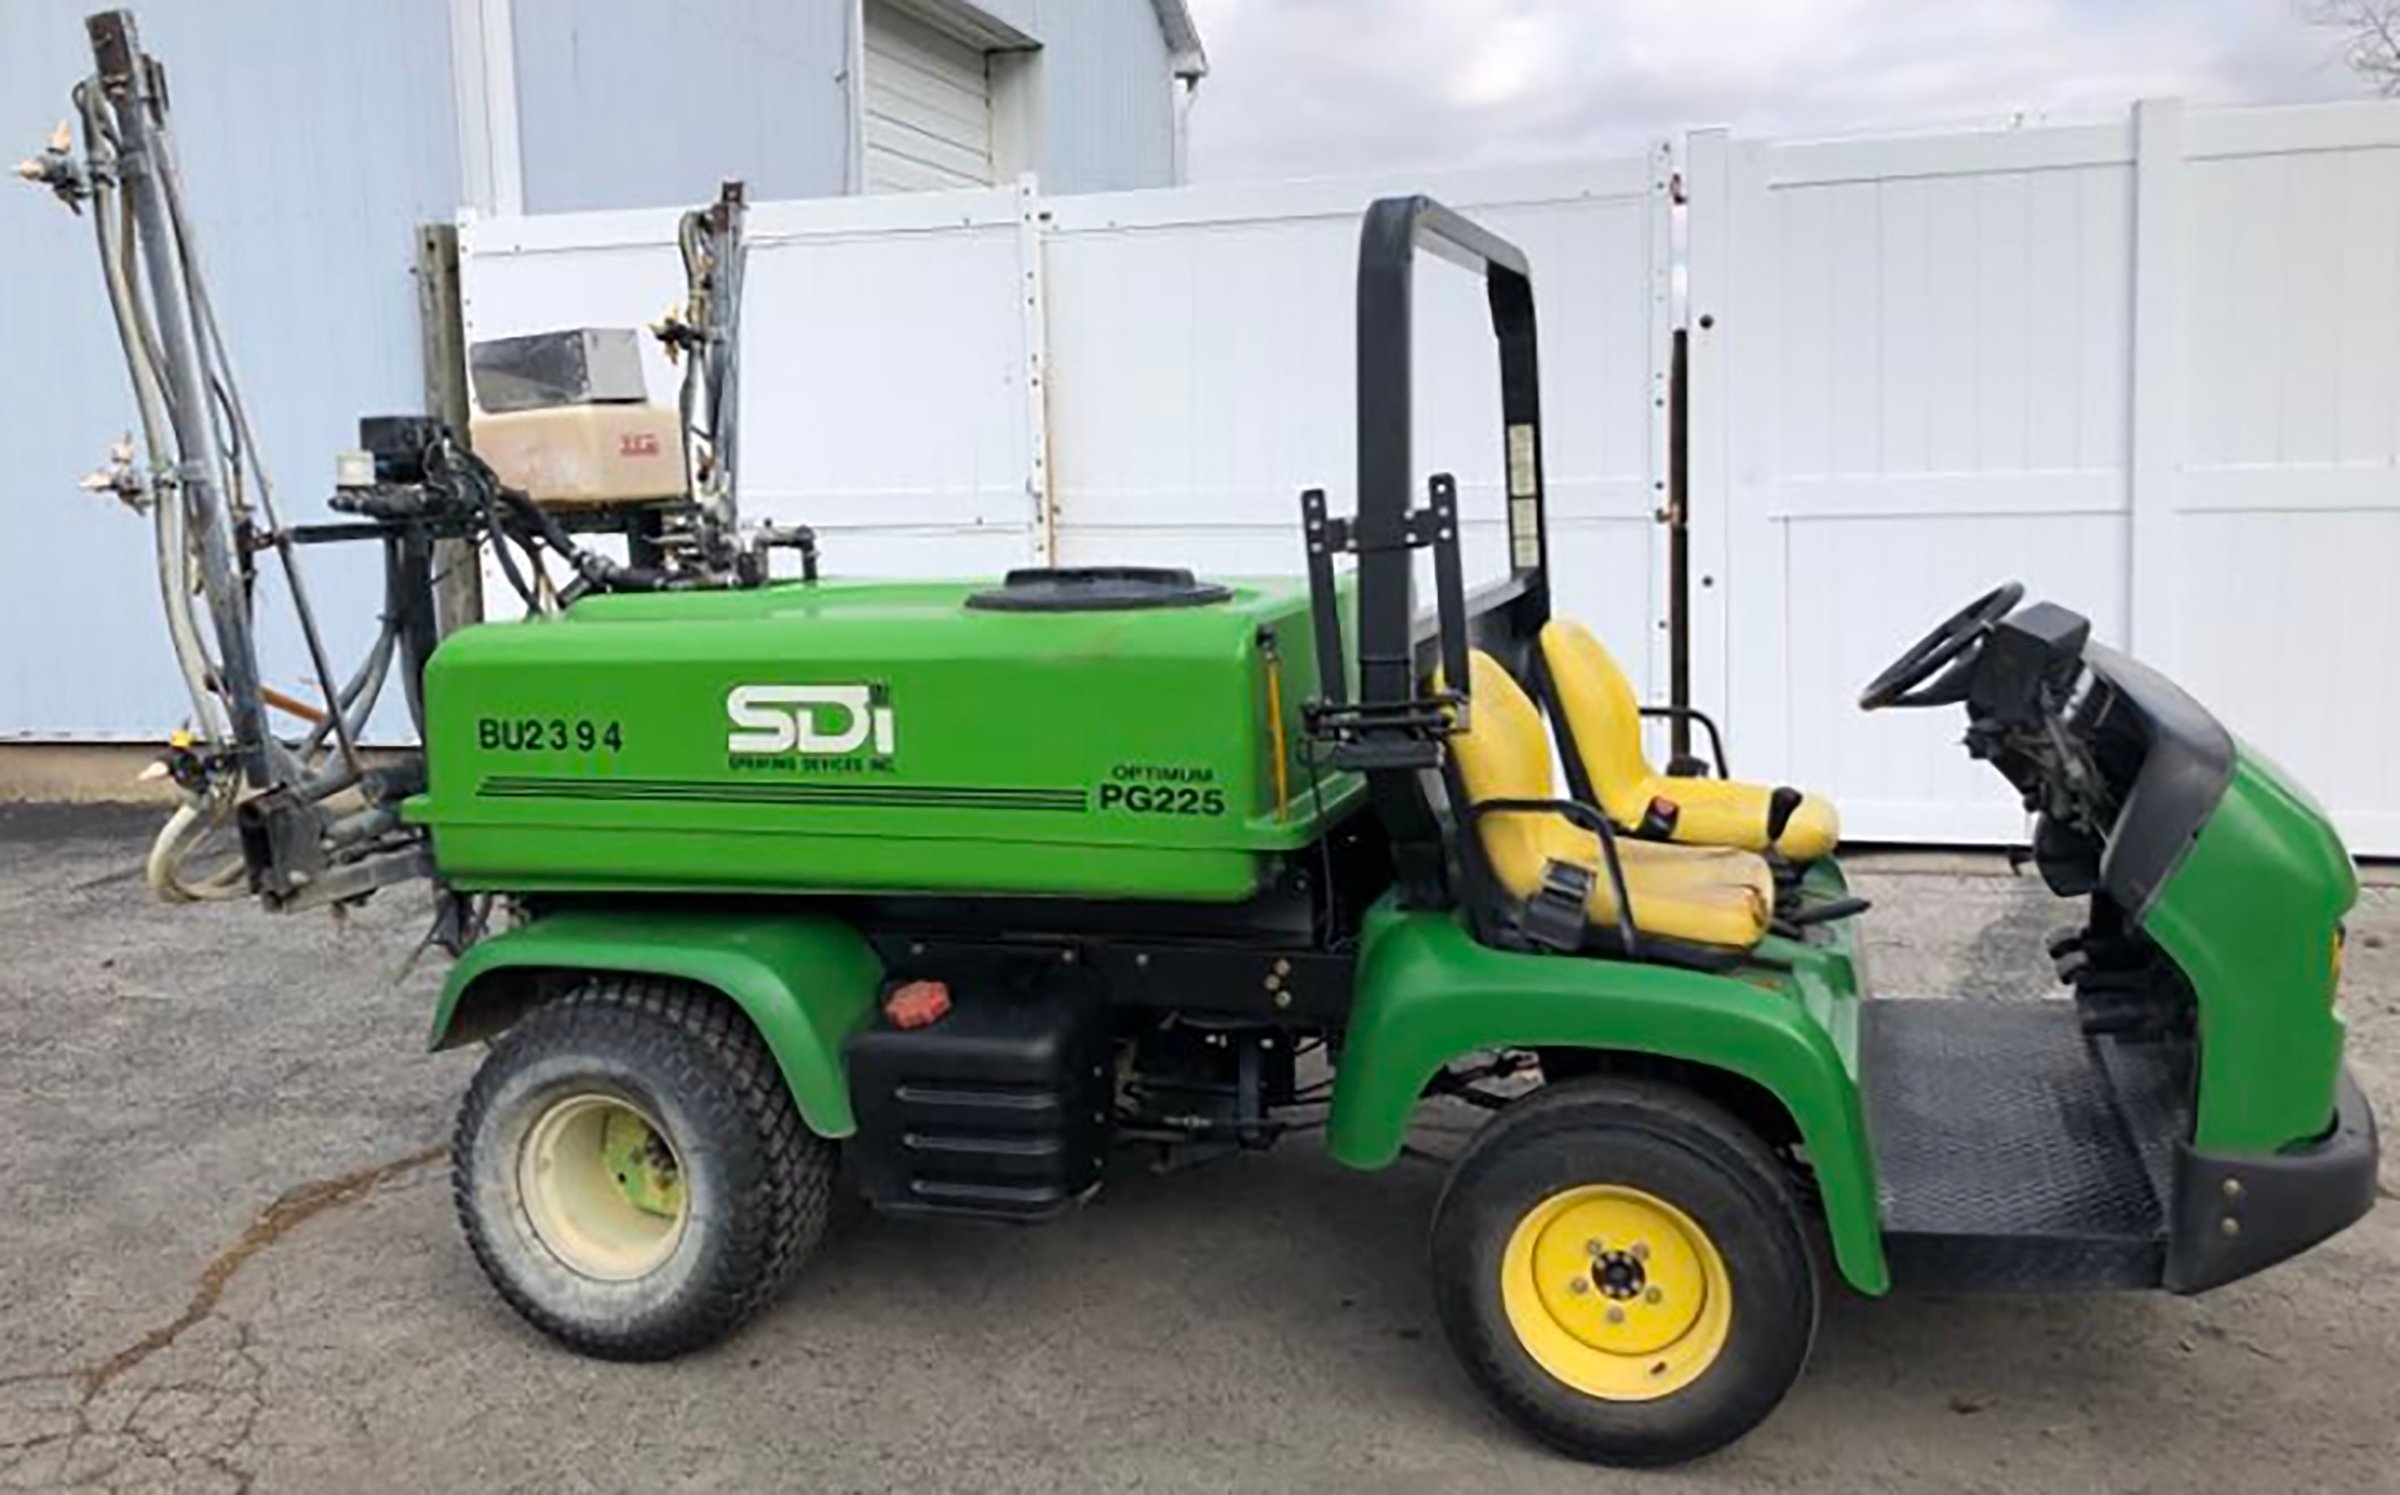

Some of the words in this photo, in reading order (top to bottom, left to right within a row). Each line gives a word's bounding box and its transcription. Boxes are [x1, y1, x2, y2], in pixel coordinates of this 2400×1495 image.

[479, 718, 623, 753] BU2394
[1111, 765, 1213, 782] OPTIMUM
[1100, 783, 1224, 815] PG225
